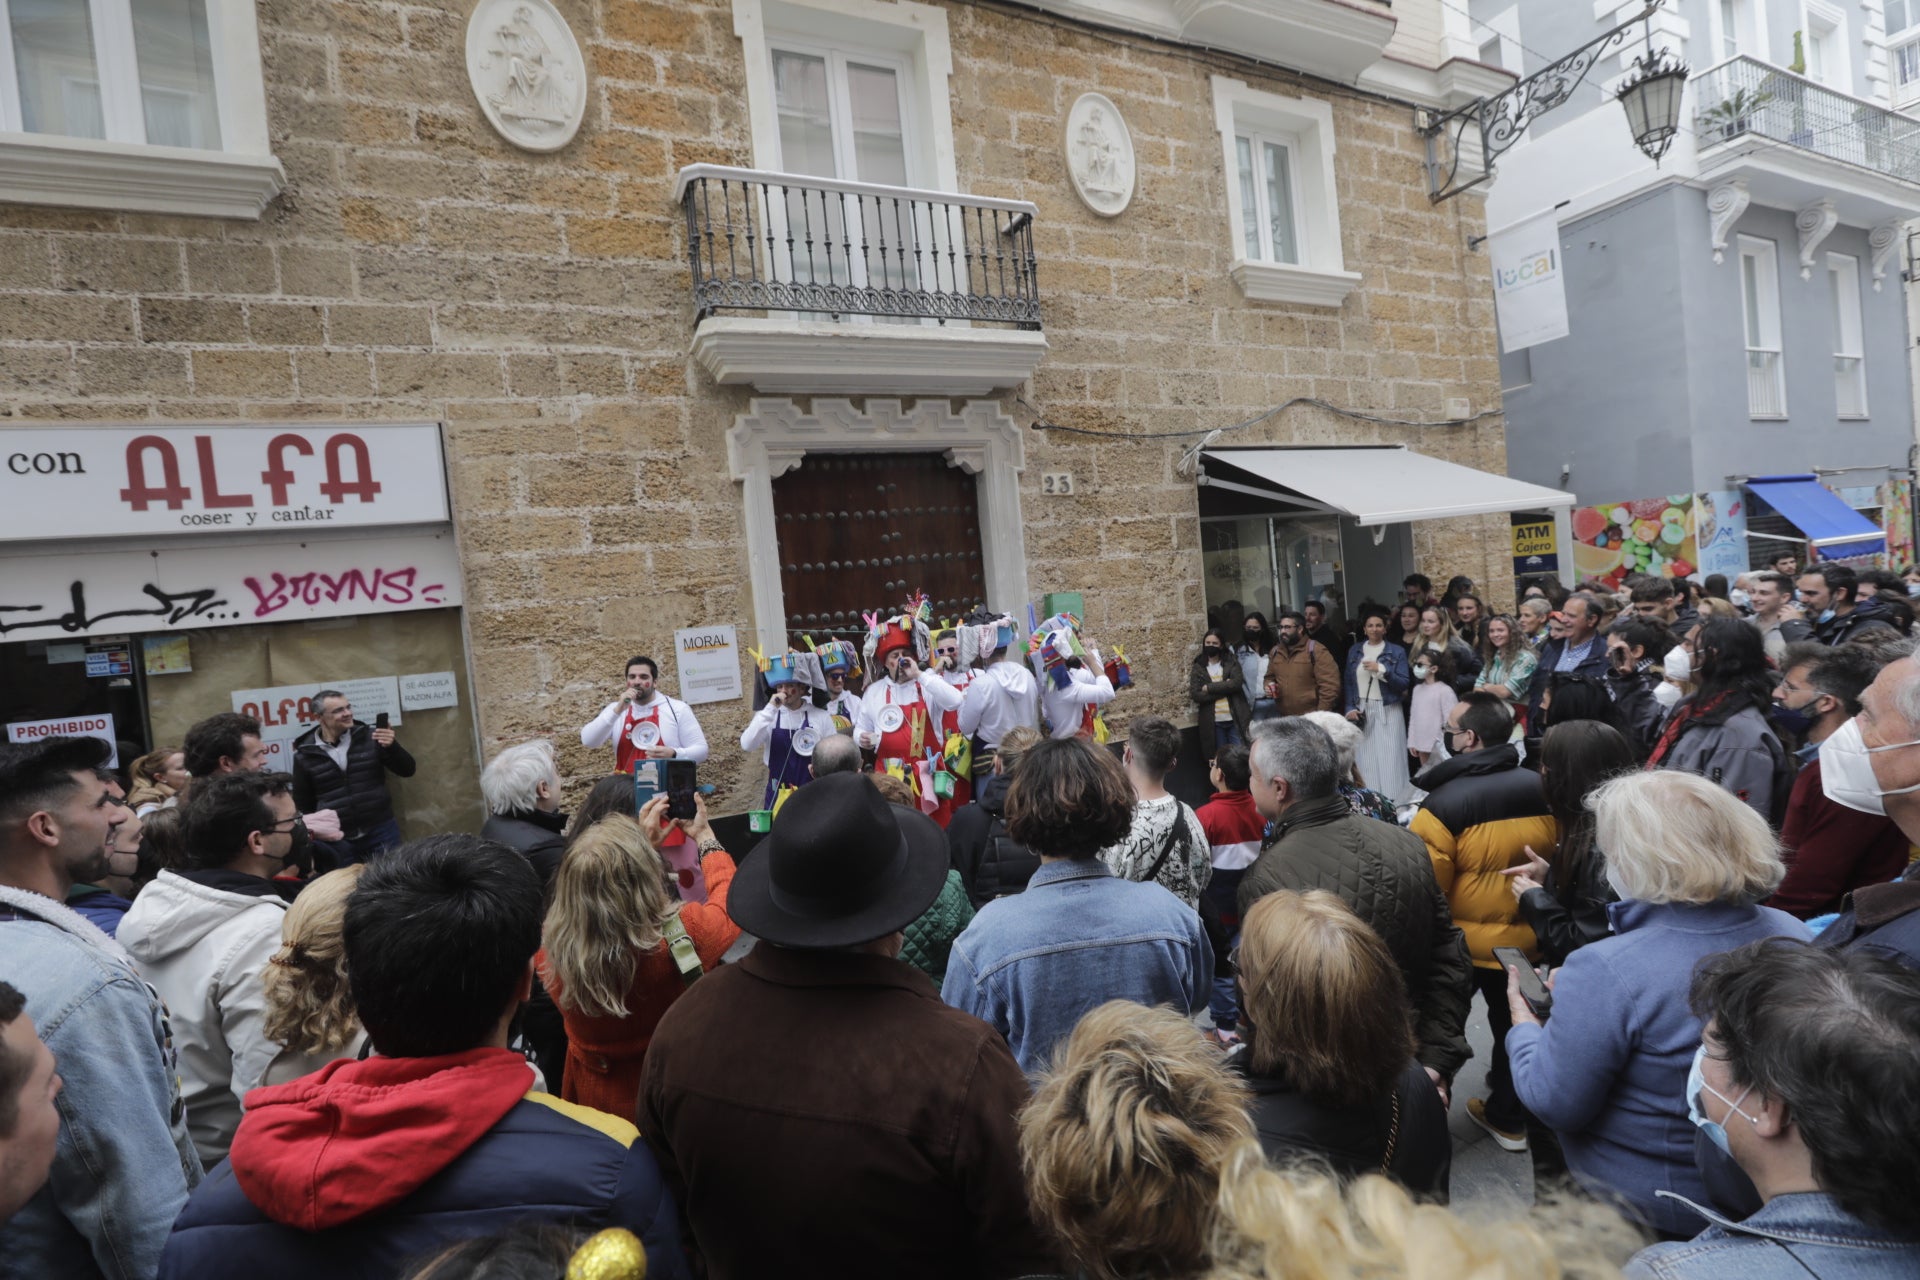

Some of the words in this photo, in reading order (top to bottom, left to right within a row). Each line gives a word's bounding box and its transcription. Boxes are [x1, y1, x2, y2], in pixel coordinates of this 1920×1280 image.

[8, 450, 86, 475] con
[119, 432, 382, 512] ALFA
[180, 511, 232, 526] coser
[246, 511, 258, 526] y
[271, 504, 335, 522] cantar
[1516, 525, 1550, 540] ATM
[1516, 541, 1551, 554] Cajero
[683, 634, 729, 650] MORAL
[88, 653, 107, 663] VISA
[16, 718, 107, 739] PROHIBIDO
